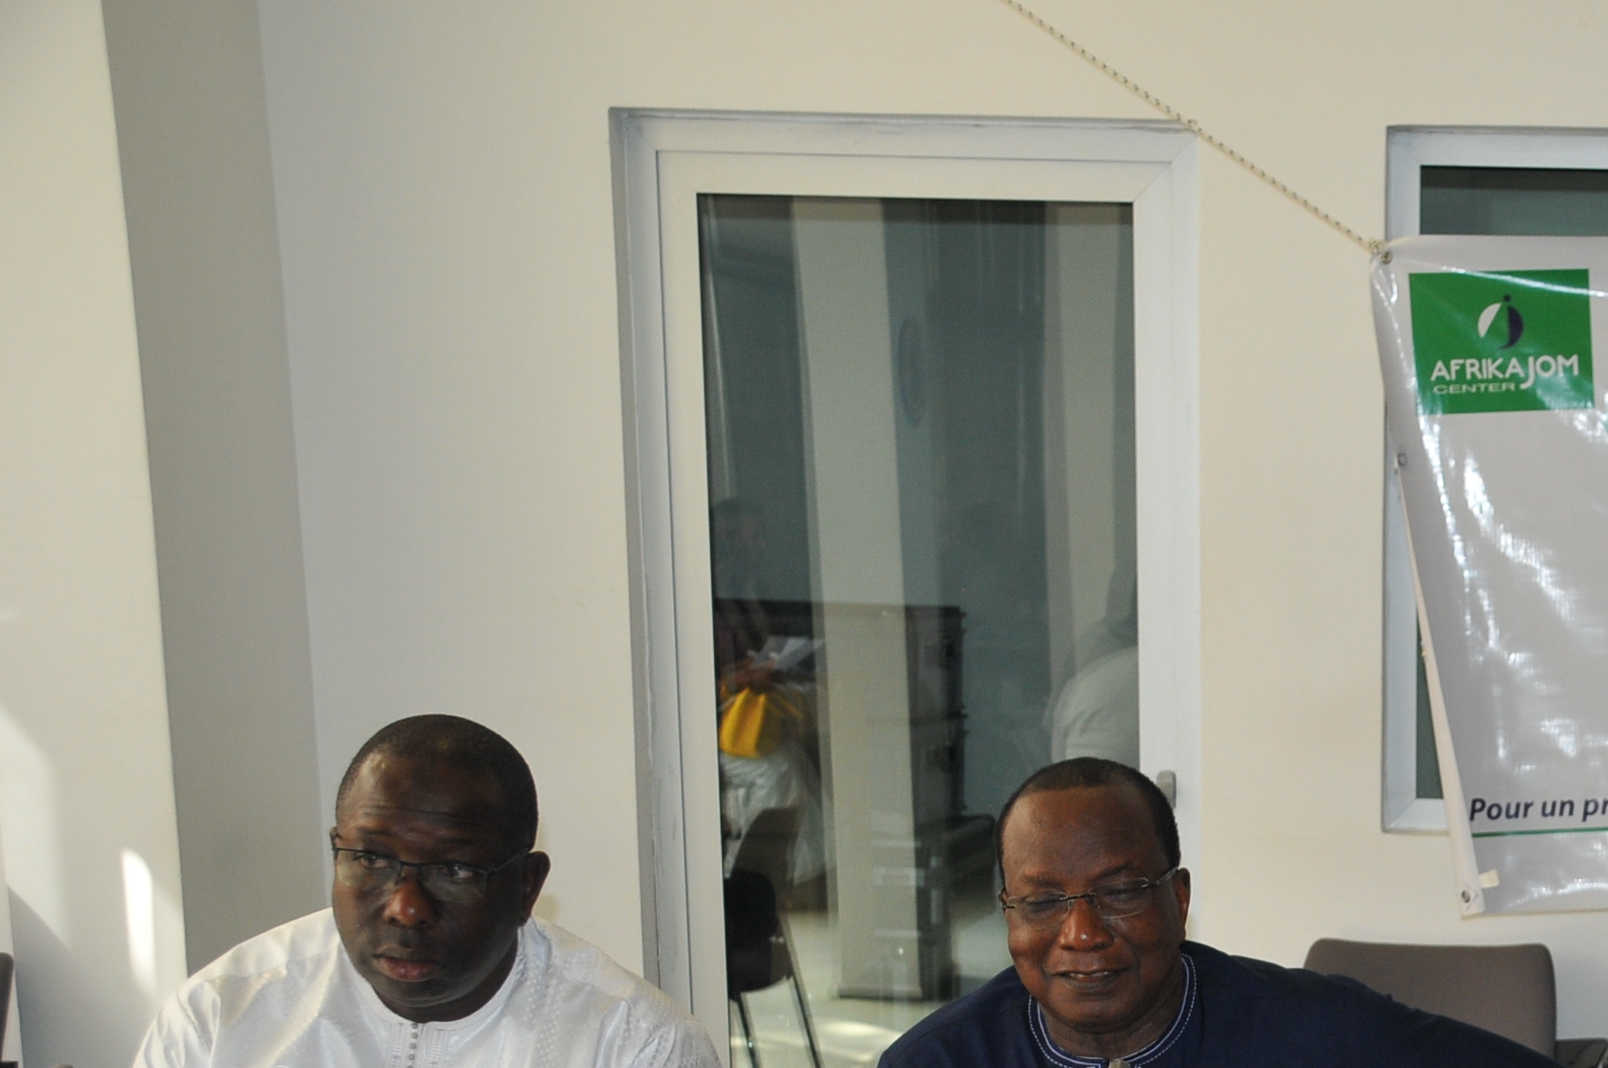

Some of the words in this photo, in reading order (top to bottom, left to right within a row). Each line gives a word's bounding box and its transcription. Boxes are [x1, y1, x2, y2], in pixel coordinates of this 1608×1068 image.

[1430, 354, 1579, 389] AFRIKAJOM
[1433, 382, 1516, 395] CENTER
[1469, 797, 1534, 821] Pour
[1541, 799, 1575, 818] un
